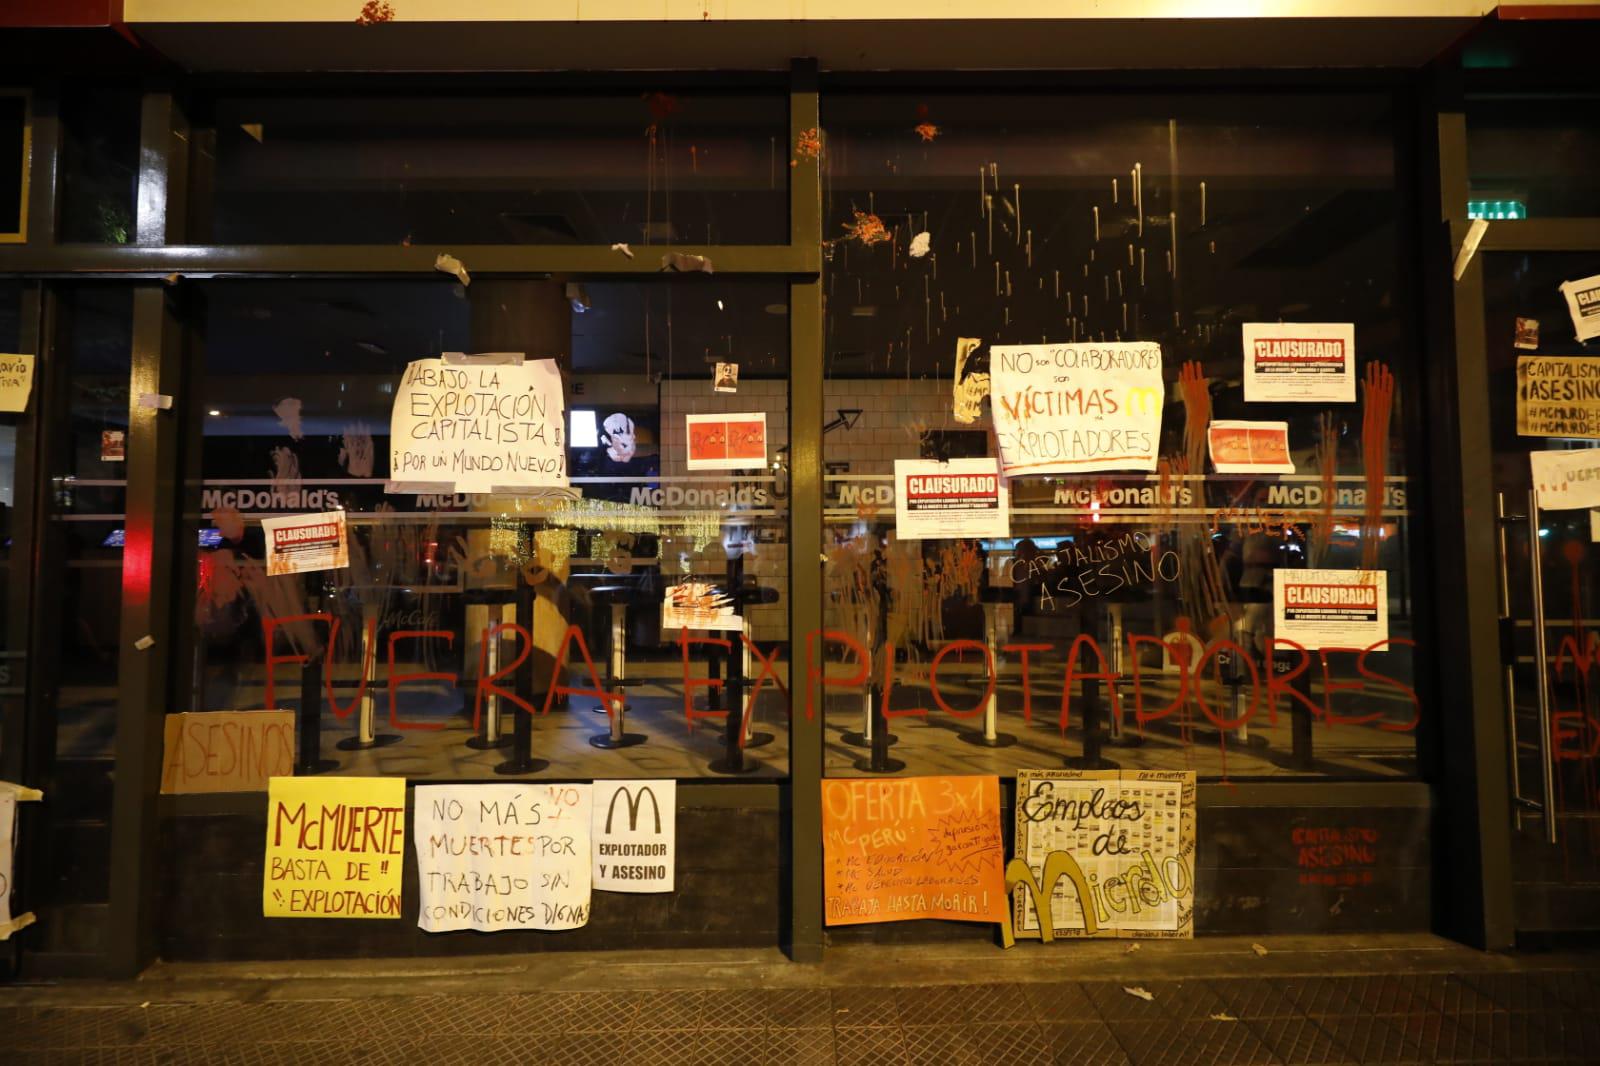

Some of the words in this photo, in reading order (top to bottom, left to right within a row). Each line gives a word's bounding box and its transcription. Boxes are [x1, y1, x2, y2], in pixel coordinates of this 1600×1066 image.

[1256, 341, 1343, 358] CLAUSURADO
[1001, 351, 1034, 374] NO
[1527, 361, 1600, 379] CAPITALISM
[479, 370, 500, 390] LA
[410, 386, 546, 419] EXPLOTACIÓN
[1001, 384, 1119, 420] VÍCTIMAS
[998, 428, 1151, 464] EXPLOTADORES
[629, 487, 768, 506] McDonald's
[909, 476, 995, 494] CLAUSURADO
[1053, 485, 1193, 505] McDonald's
[1267, 485, 1406, 505] McDonad's
[201, 489, 339, 509] McDonald's
[275, 526, 337, 542] CLAUSURADO
[1009, 531, 1151, 584] CAPITALISMO
[1040, 551, 1180, 611] ASESINO
[1287, 587, 1375, 604] CLAUSURADO
[262, 612, 627, 734] FUERA
[676, 626, 1421, 748] EXPLOTADORES
[166, 721, 294, 785] ASESINOS
[432, 799, 463, 821] NO
[480, 794, 541, 826] MÁS
[826, 781, 926, 822] OFERTA
[1022, 782, 1146, 831] Empleos
[429, 835, 535, 858] MUERTES
[537, 835, 576, 857] POR
[599, 843, 667, 857] EXPLOTADOR
[1092, 824, 1132, 857] de
[271, 857, 331, 880] BASTA
[345, 861, 370, 881] DE
[599, 864, 607, 879] Y
[612, 865, 666, 880] ASESINO
[426, 872, 529, 896] TRABAJO
[540, 873, 569, 890] SIN
[290, 888, 402, 915] EXPLOTACIÓN
[423, 901, 535, 923] CONDICIONES
[888, 892, 928, 913] HASTA
